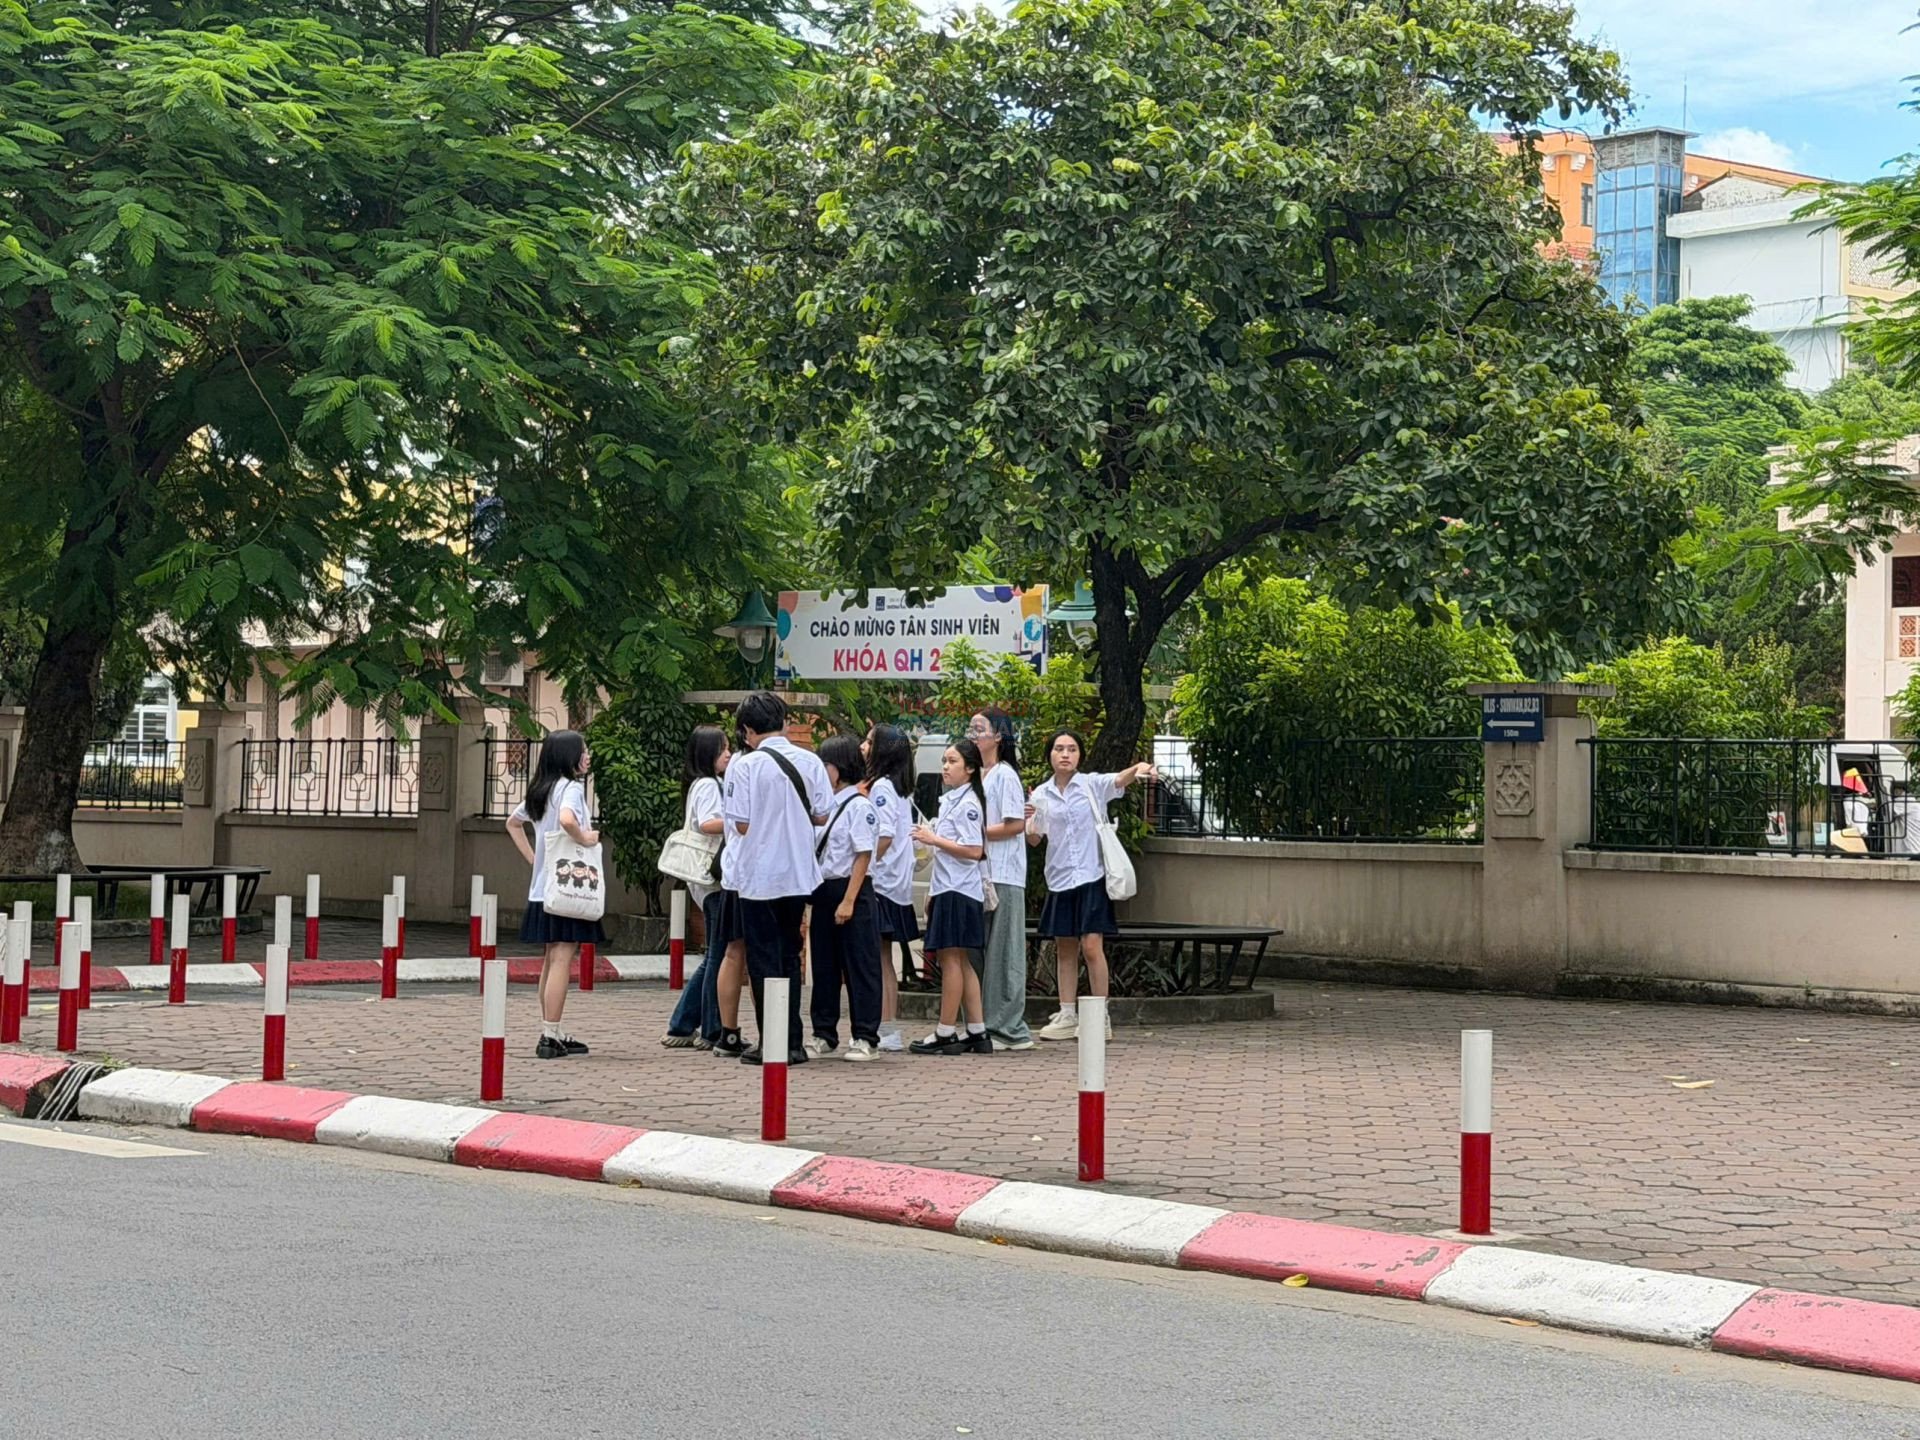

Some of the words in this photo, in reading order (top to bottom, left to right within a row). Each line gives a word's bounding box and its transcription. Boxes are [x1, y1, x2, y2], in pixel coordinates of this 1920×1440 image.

[810, 616, 850, 638] CHÀO
[854, 616, 895, 637] MỪNG
[899, 615, 926, 637] TÂN
[930, 618, 963, 636] SINH
[969, 614, 1000, 636] VIÊN
[833, 643, 888, 672] KHÓA
[894, 648, 923, 672] QH
[1503, 729, 1519, 738] 150m
